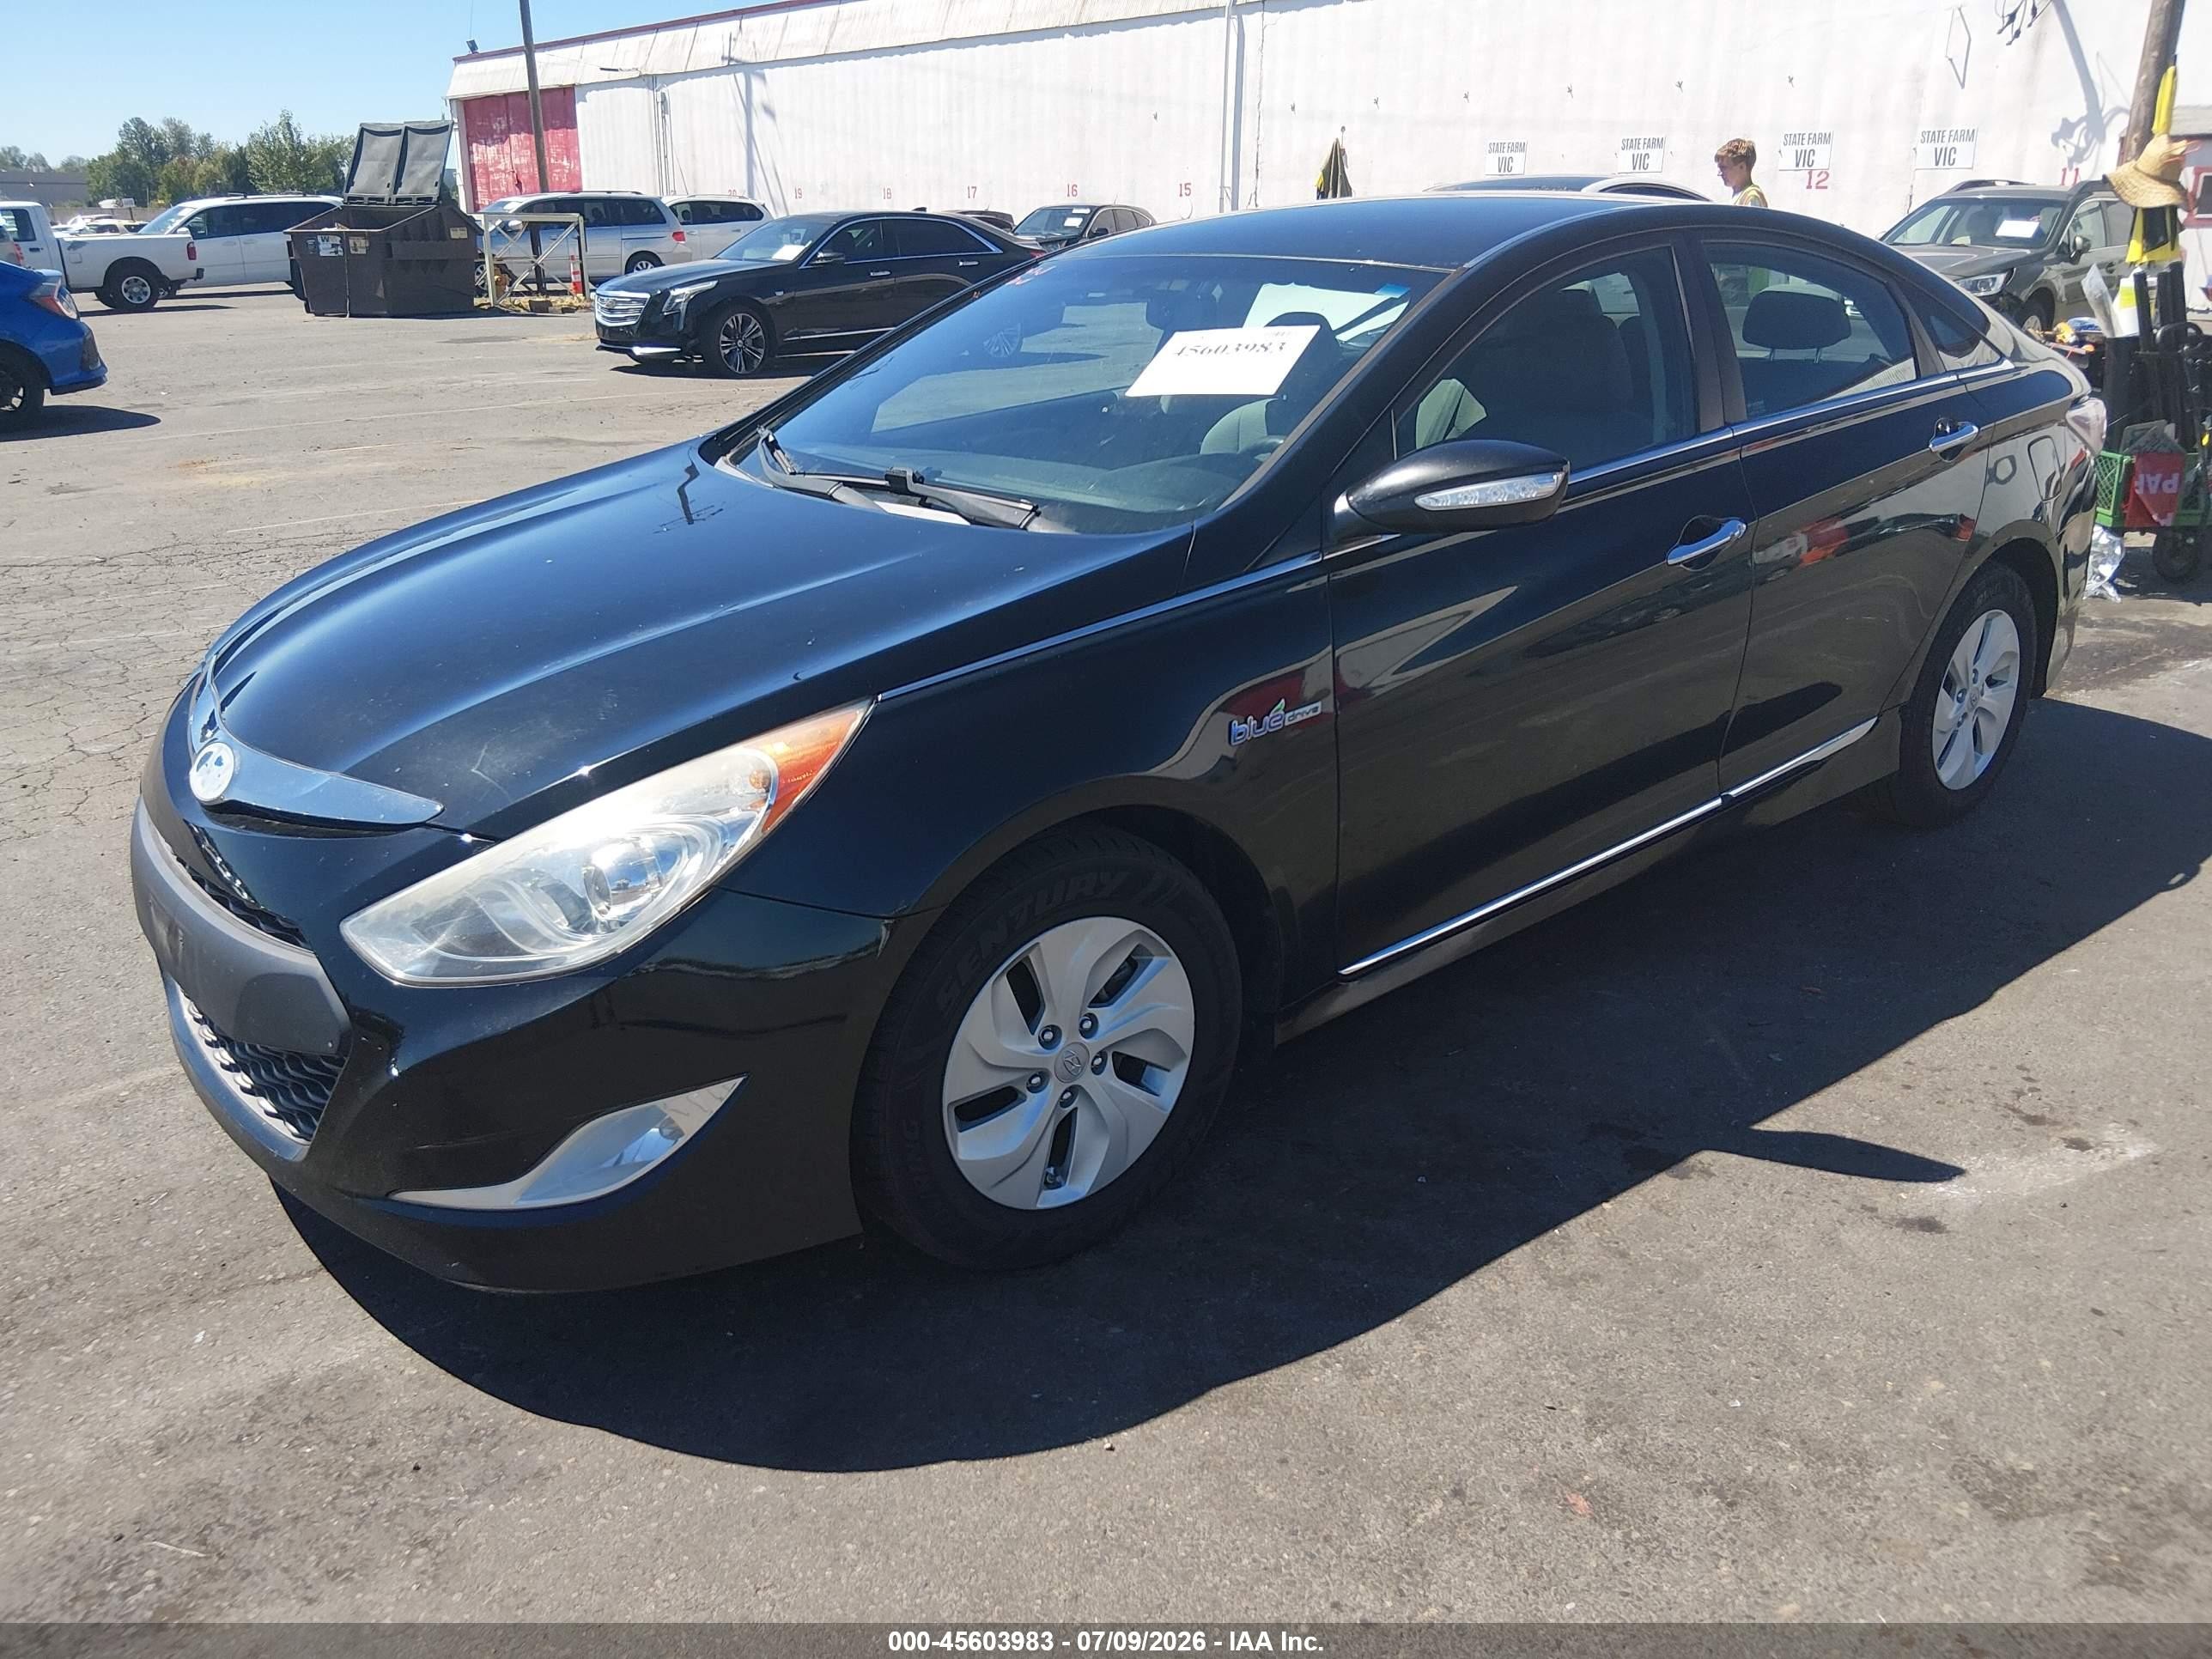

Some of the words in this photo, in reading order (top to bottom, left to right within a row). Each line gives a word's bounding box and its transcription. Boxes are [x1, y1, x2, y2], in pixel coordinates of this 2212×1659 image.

[1621, 138, 1641, 151] STATE
[1643, 137, 1663, 150] FARM
[1784, 133, 1806, 146] STATE
[1808, 132, 1832, 145] FARM
[1920, 131, 1946, 144] STATE
[1948, 129, 1975, 143] FARM
[1488, 142, 1505, 154] STATE
[1506, 142, 1525, 154] FARM
[1497, 156, 1514, 173] VIC
[1631, 153, 1650, 171] VIC
[1795, 149, 1815, 167] VIC
[1934, 147, 1956, 167] VIC
[1806, 171, 1830, 189] 12
[794, 188, 803, 199] 19
[883, 187, 891, 199] 18
[967, 186, 977, 198] 17
[1066, 184, 1078, 198] 16
[1179, 183, 1192, 198] 15
[1230, 712, 1285, 745] blue
